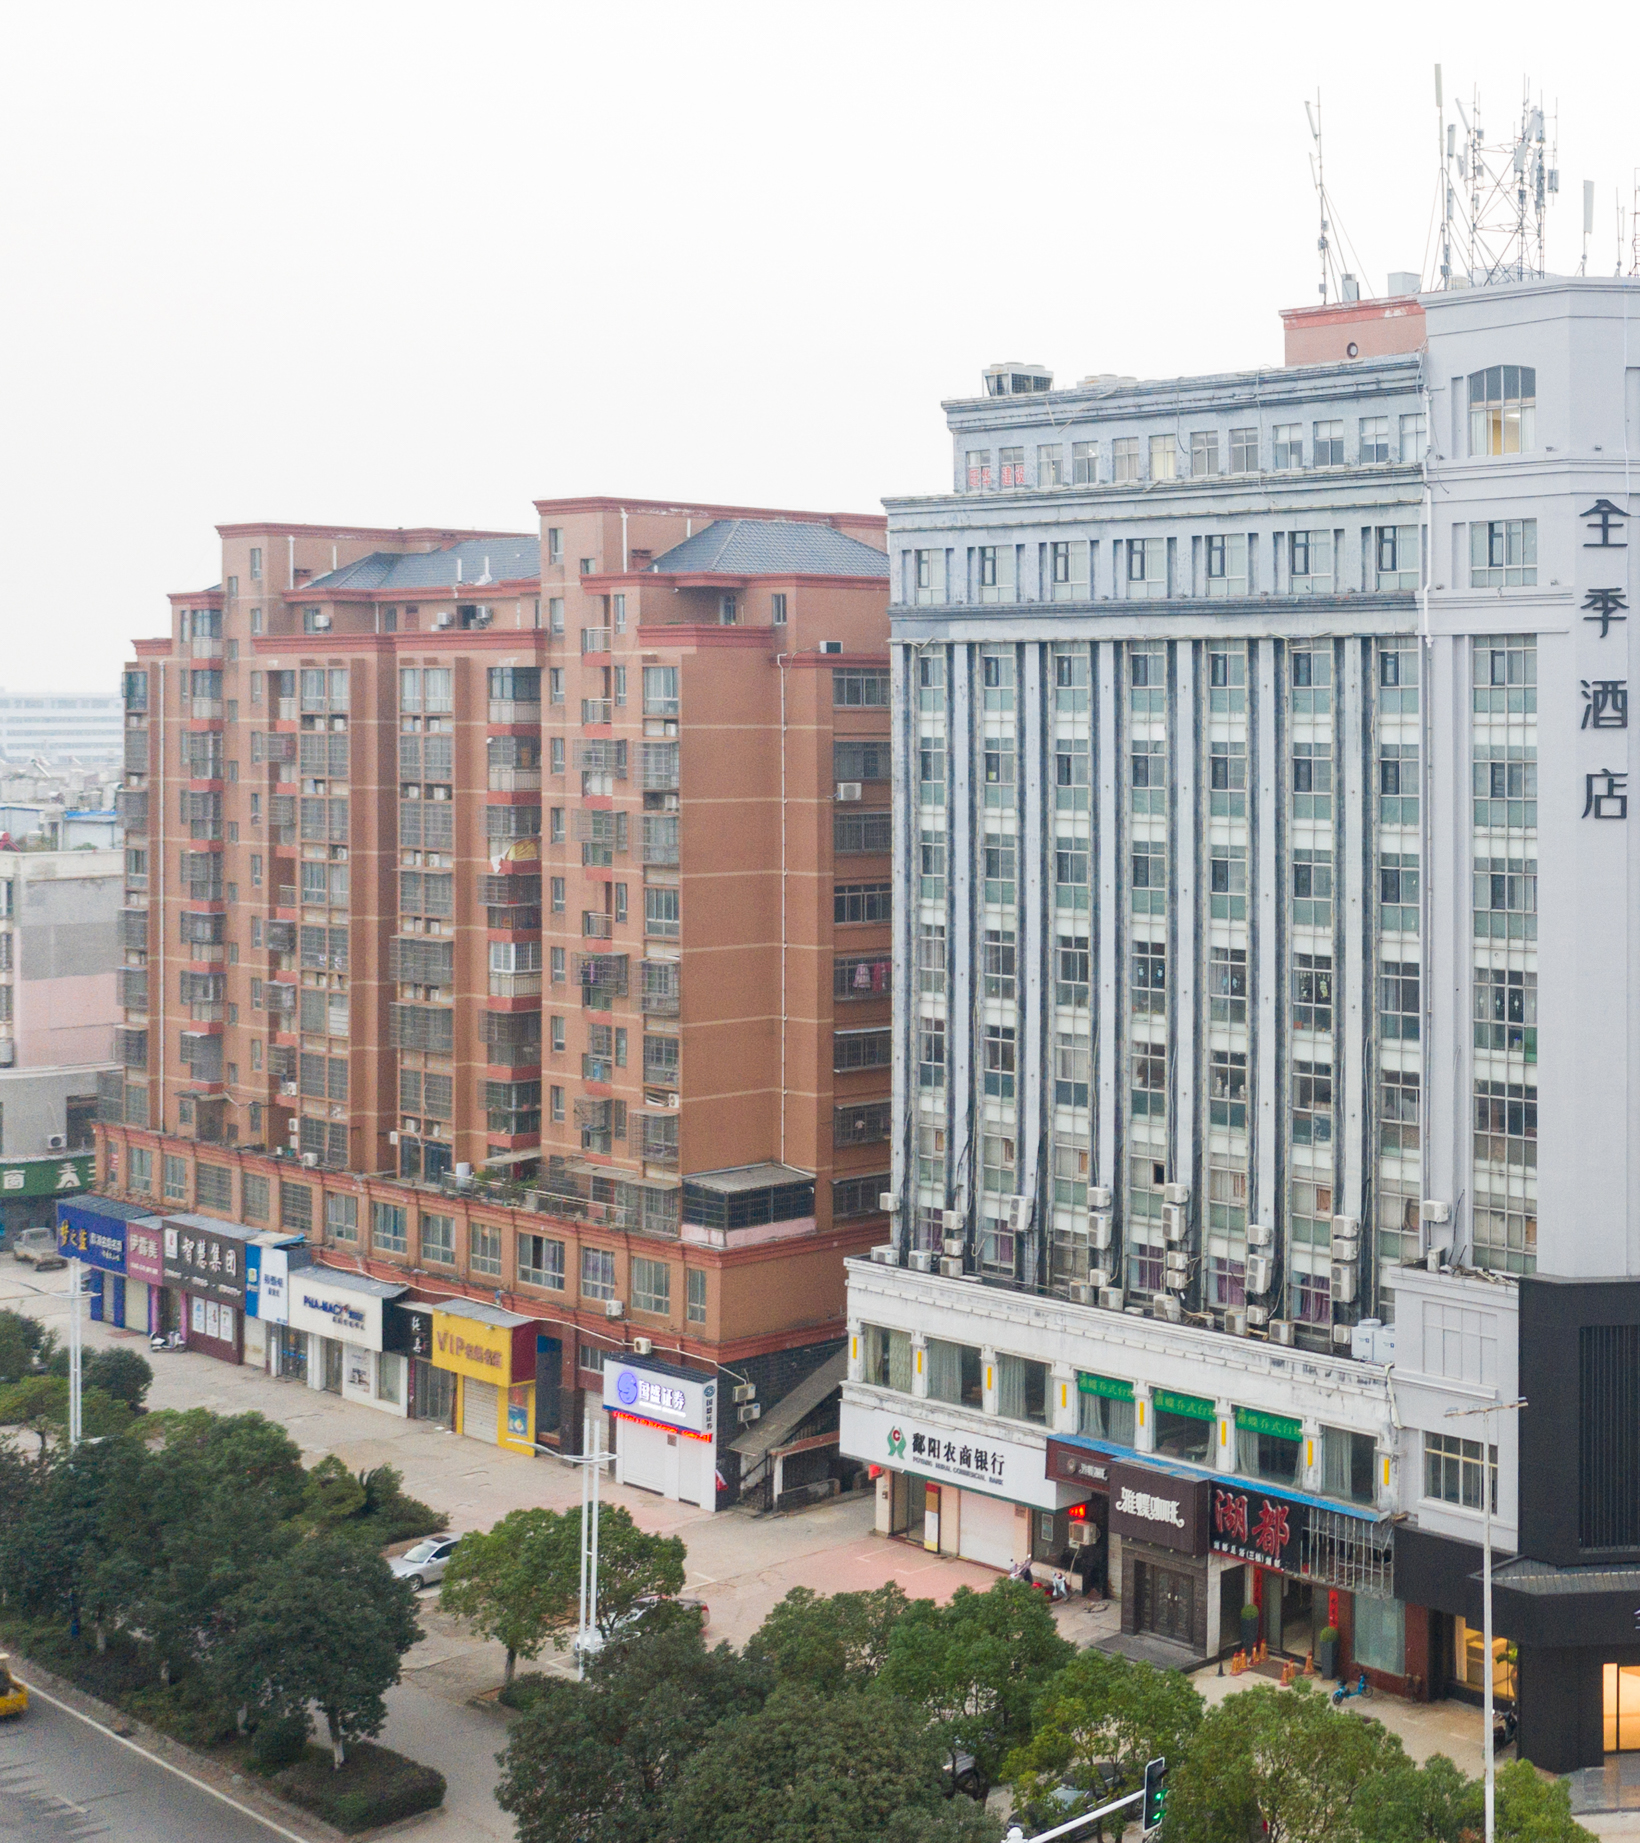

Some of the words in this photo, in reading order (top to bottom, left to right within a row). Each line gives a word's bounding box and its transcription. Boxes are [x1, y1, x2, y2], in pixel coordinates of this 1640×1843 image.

[1579, 499, 1631, 819] 全季酒店
[181, 1236, 237, 1277] 智慧集团
[437, 1330, 465, 1356] VIP
[638, 1379, 686, 1411] 国盛证券
[911, 1432, 1005, 1476] 鄱阳农商银行
[1214, 1488, 1291, 1558] 湖都
